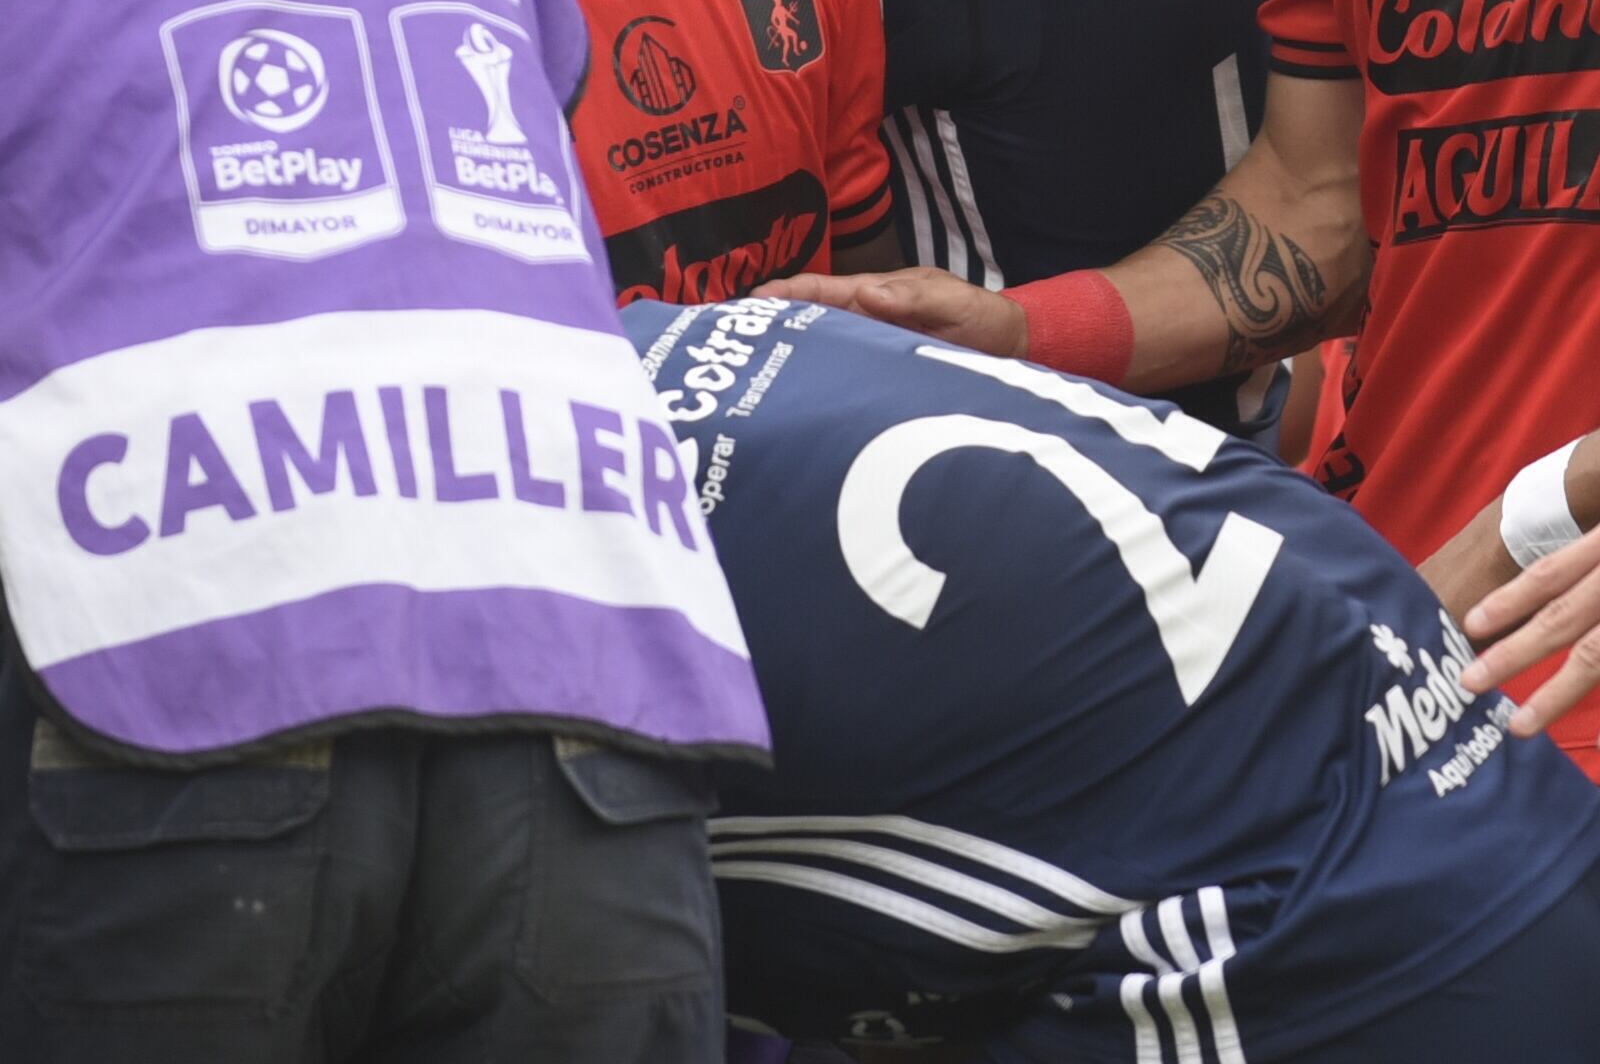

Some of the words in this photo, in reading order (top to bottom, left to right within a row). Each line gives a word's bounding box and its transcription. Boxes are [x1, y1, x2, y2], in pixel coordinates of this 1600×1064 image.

[607, 108, 748, 172] COSENZA
[212, 147, 362, 191] BetPlay
[629, 151, 745, 195] CONSTRUCTORA
[245, 215, 357, 235] DIMAYOR
[474, 213, 574, 241] DIMAYOR
